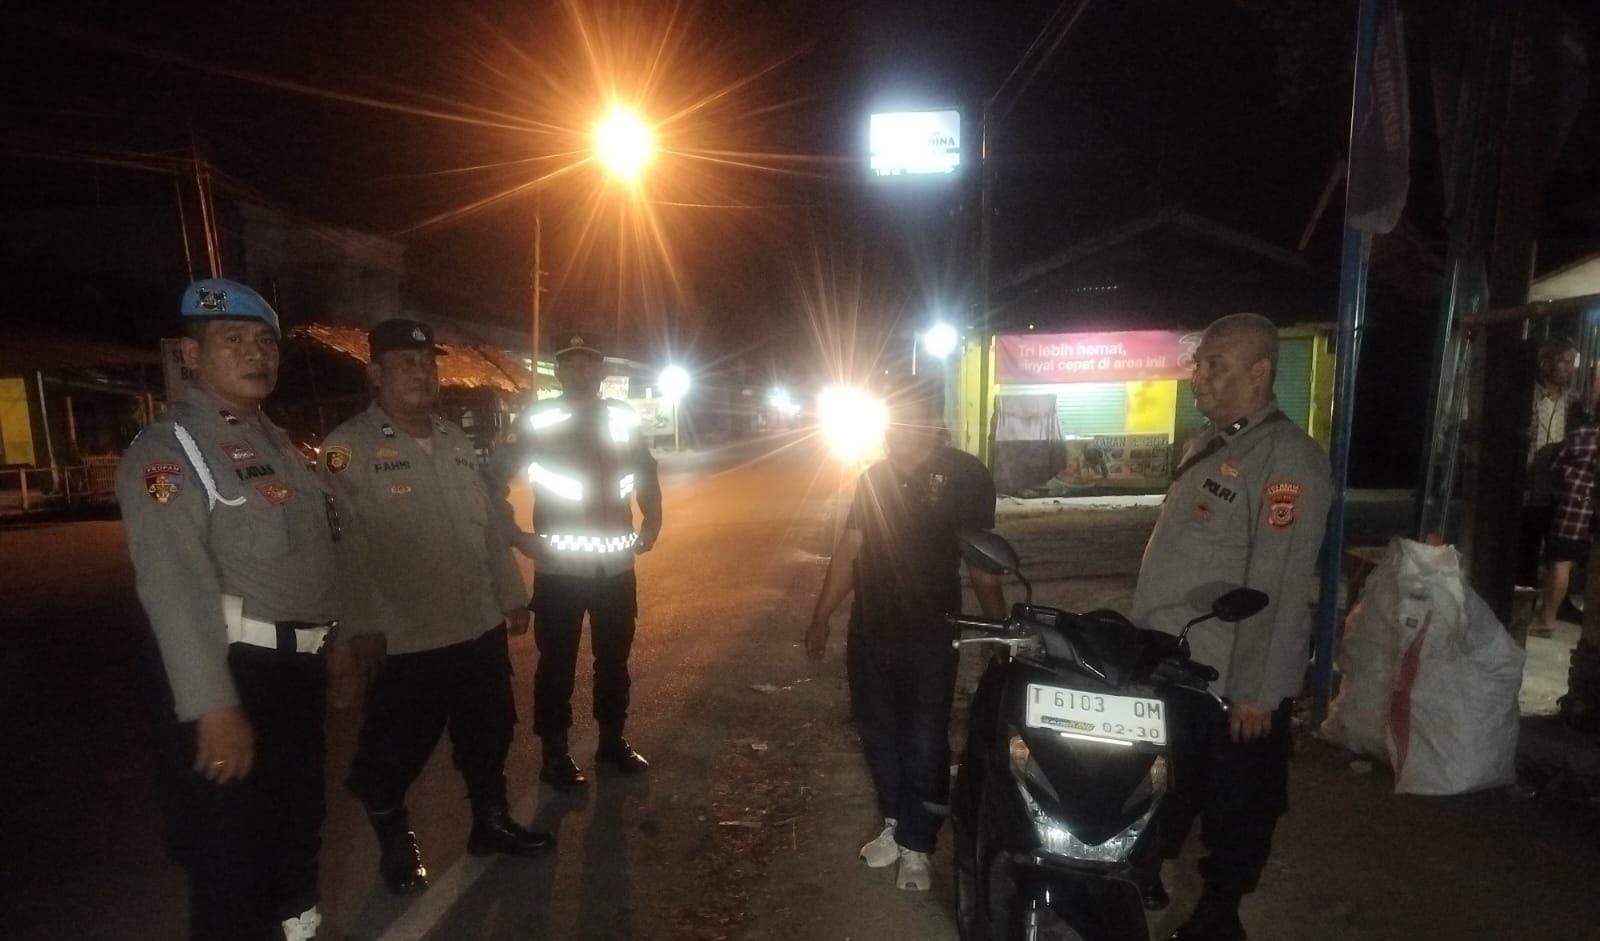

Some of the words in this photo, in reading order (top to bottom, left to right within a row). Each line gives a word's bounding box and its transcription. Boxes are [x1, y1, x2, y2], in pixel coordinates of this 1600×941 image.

[1018, 345, 1035, 358] Tri
[1039, 343, 1073, 357] lebih
[1077, 341, 1127, 356] hemat,
[1057, 358, 1095, 373] cepat
[1098, 356, 1110, 369] di
[1113, 357, 1142, 369] area
[375, 460, 411, 473] FAHMI
[1202, 478, 1237, 503] POLRI
[1033, 687, 1043, 704] T
[1054, 691, 1105, 713] 6103
[1102, 722, 1159, 739] 02-30
